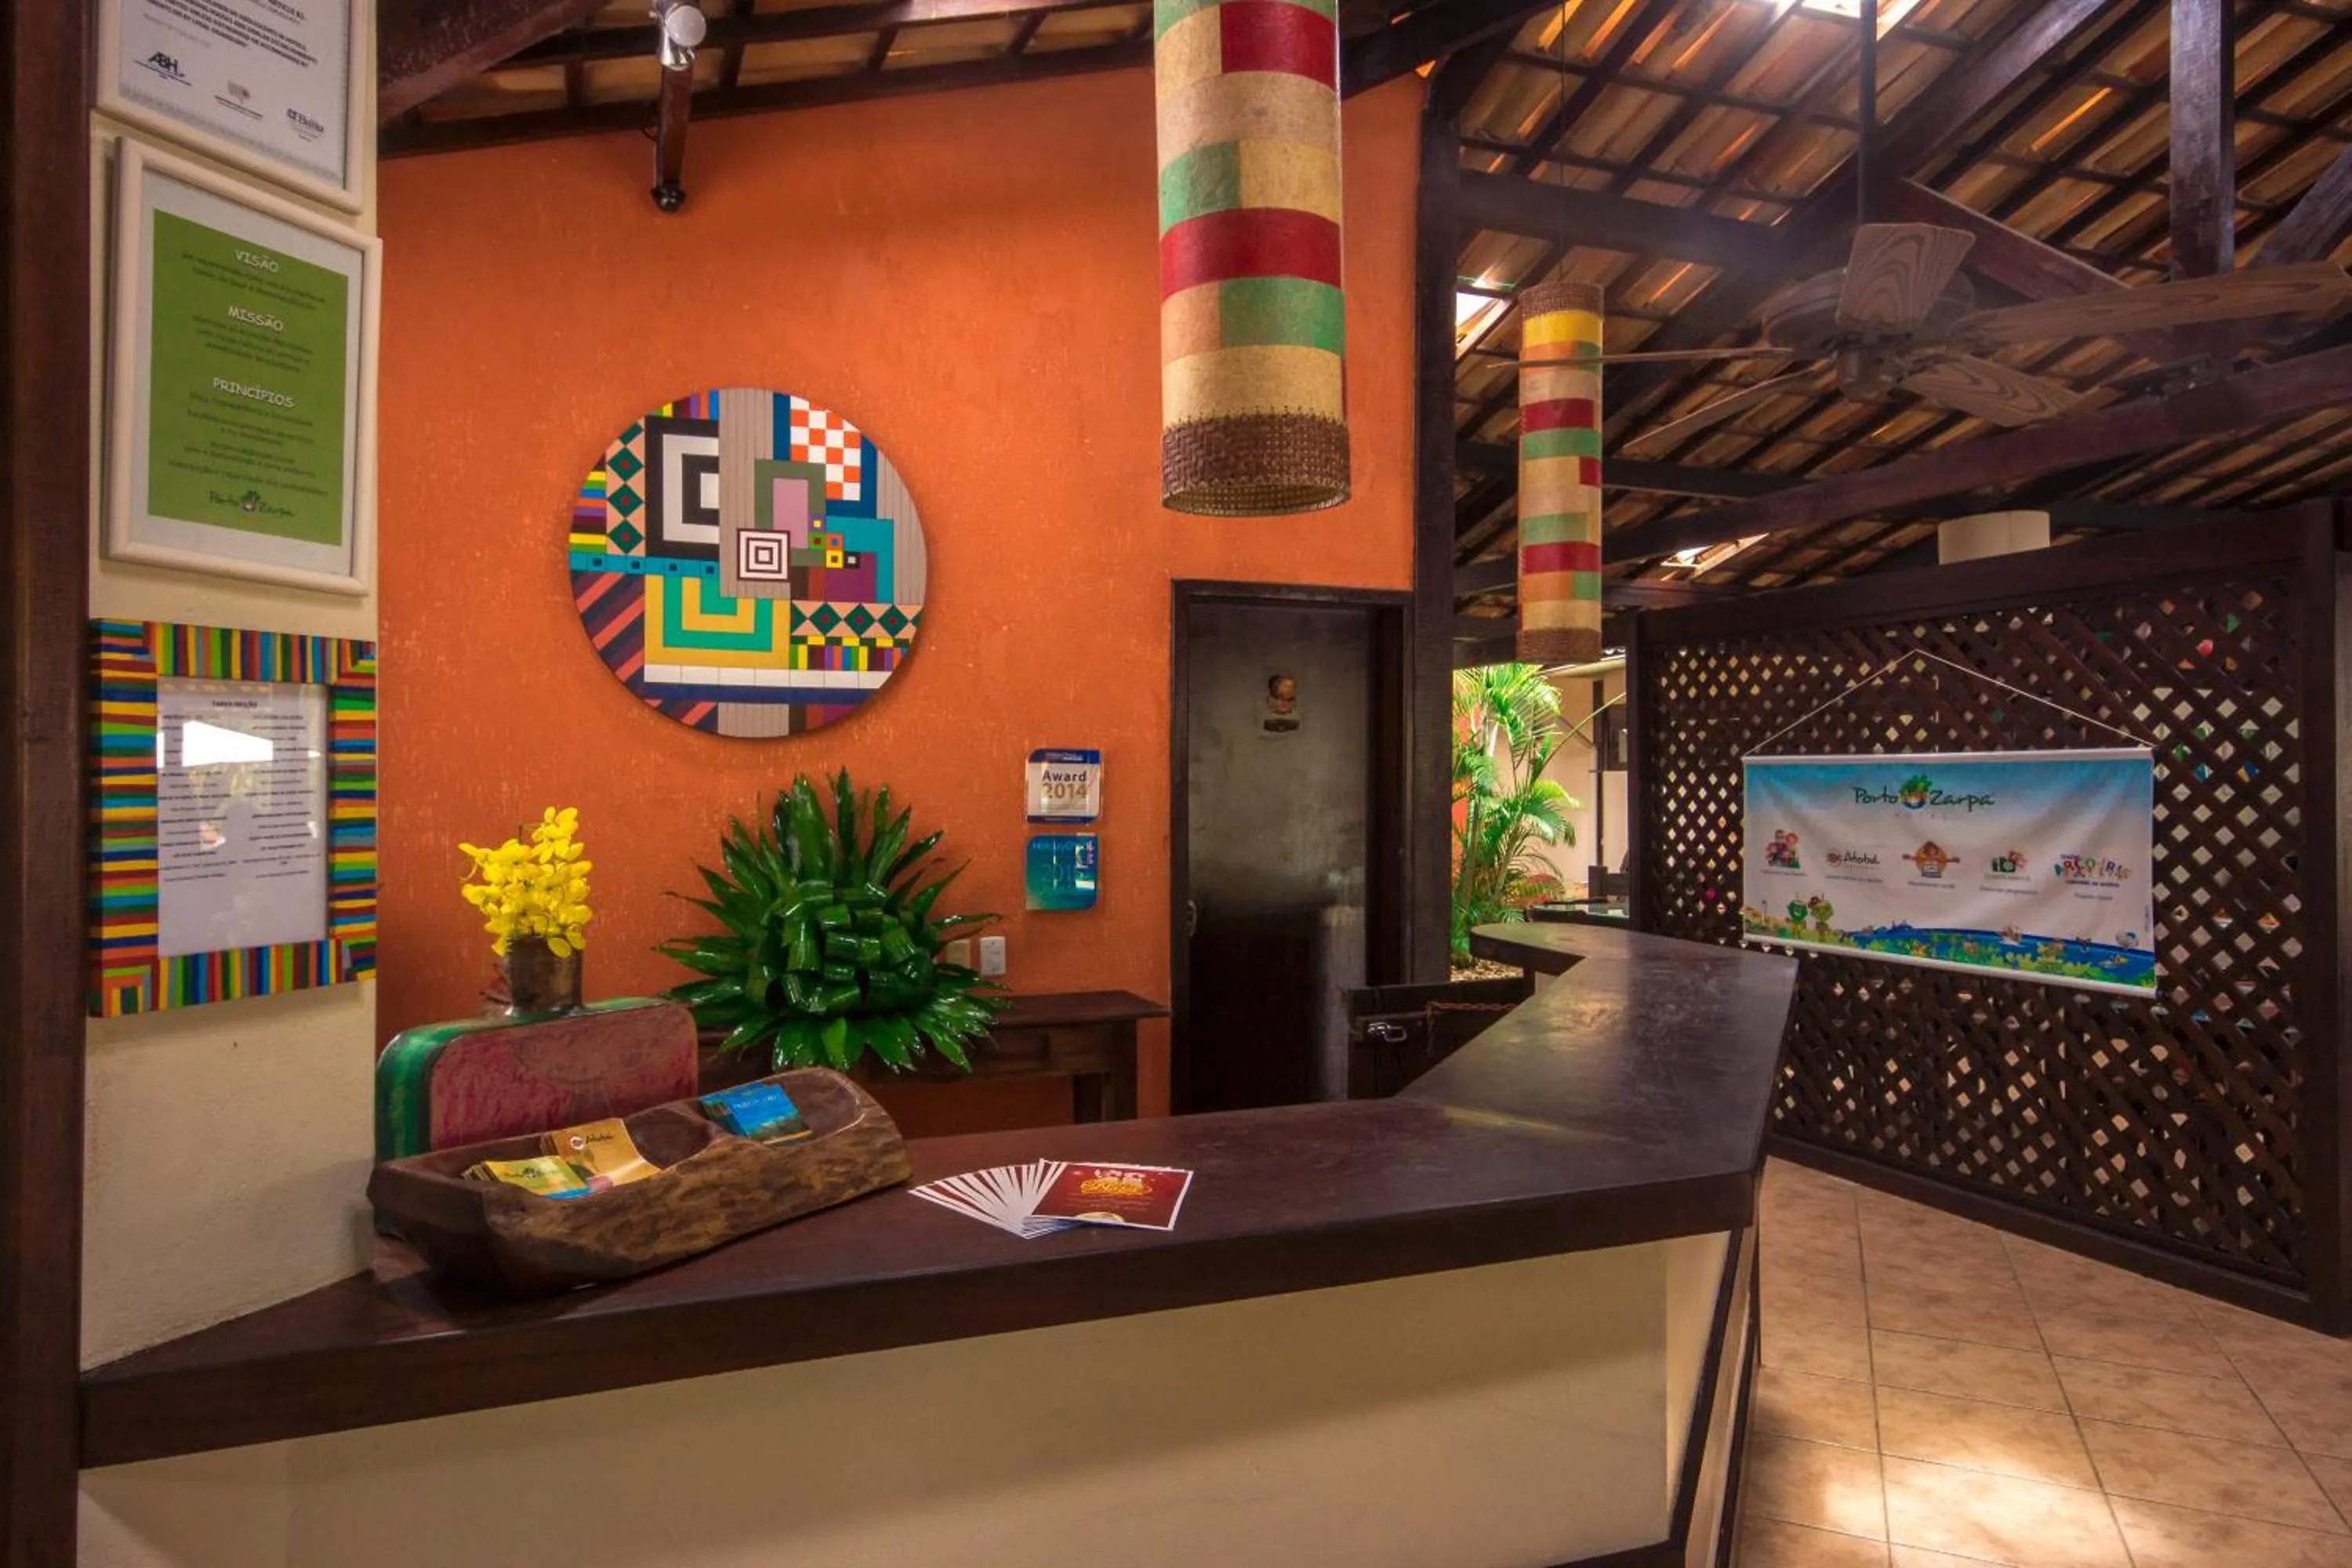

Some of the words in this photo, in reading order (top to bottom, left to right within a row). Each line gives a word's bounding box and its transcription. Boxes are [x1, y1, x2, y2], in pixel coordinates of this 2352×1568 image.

[234, 249, 279, 273] VISÃO
[227, 304, 284, 332] MISSÃO
[212, 376, 296, 408] PRINCÍPIOS
[1042, 770, 1087, 782] Award
[1042, 782, 1087, 799] 2014
[1852, 784, 1899, 804] Porto
